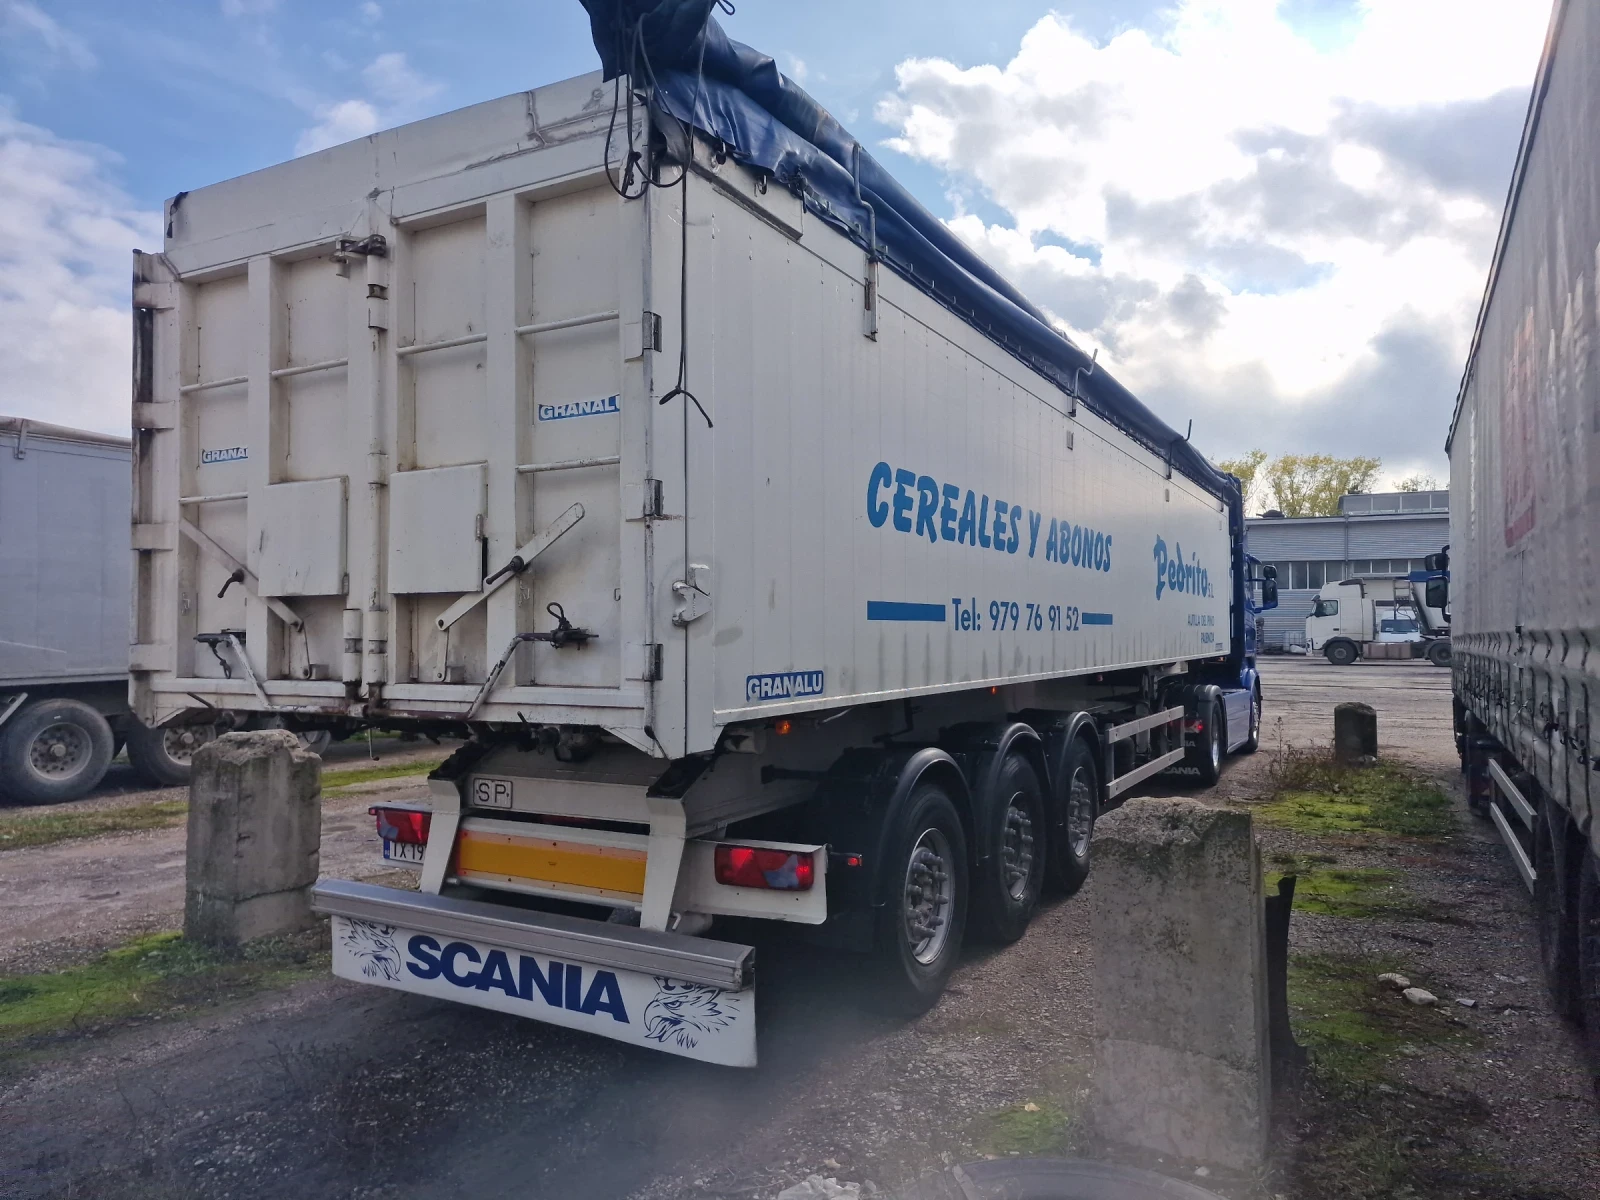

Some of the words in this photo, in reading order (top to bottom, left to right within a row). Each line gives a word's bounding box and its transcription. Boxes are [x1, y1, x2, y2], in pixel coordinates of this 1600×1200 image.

[202, 448, 248, 462] GRANA
[866, 461, 1021, 554] CEREALES
[1028, 509, 1041, 558] Y
[1045, 517, 1112, 572] ABONOS
[1153, 533, 1208, 600] Pedrito
[952, 598, 981, 631] Tel:
[989, 600, 1019, 631] 979
[1026, 604, 1042, 631] 76
[1049, 605, 1062, 631] 91
[1066, 606, 1079, 631] 52
[747, 673, 822, 698] GRANALU
[406, 935, 630, 1024] SCANIA
